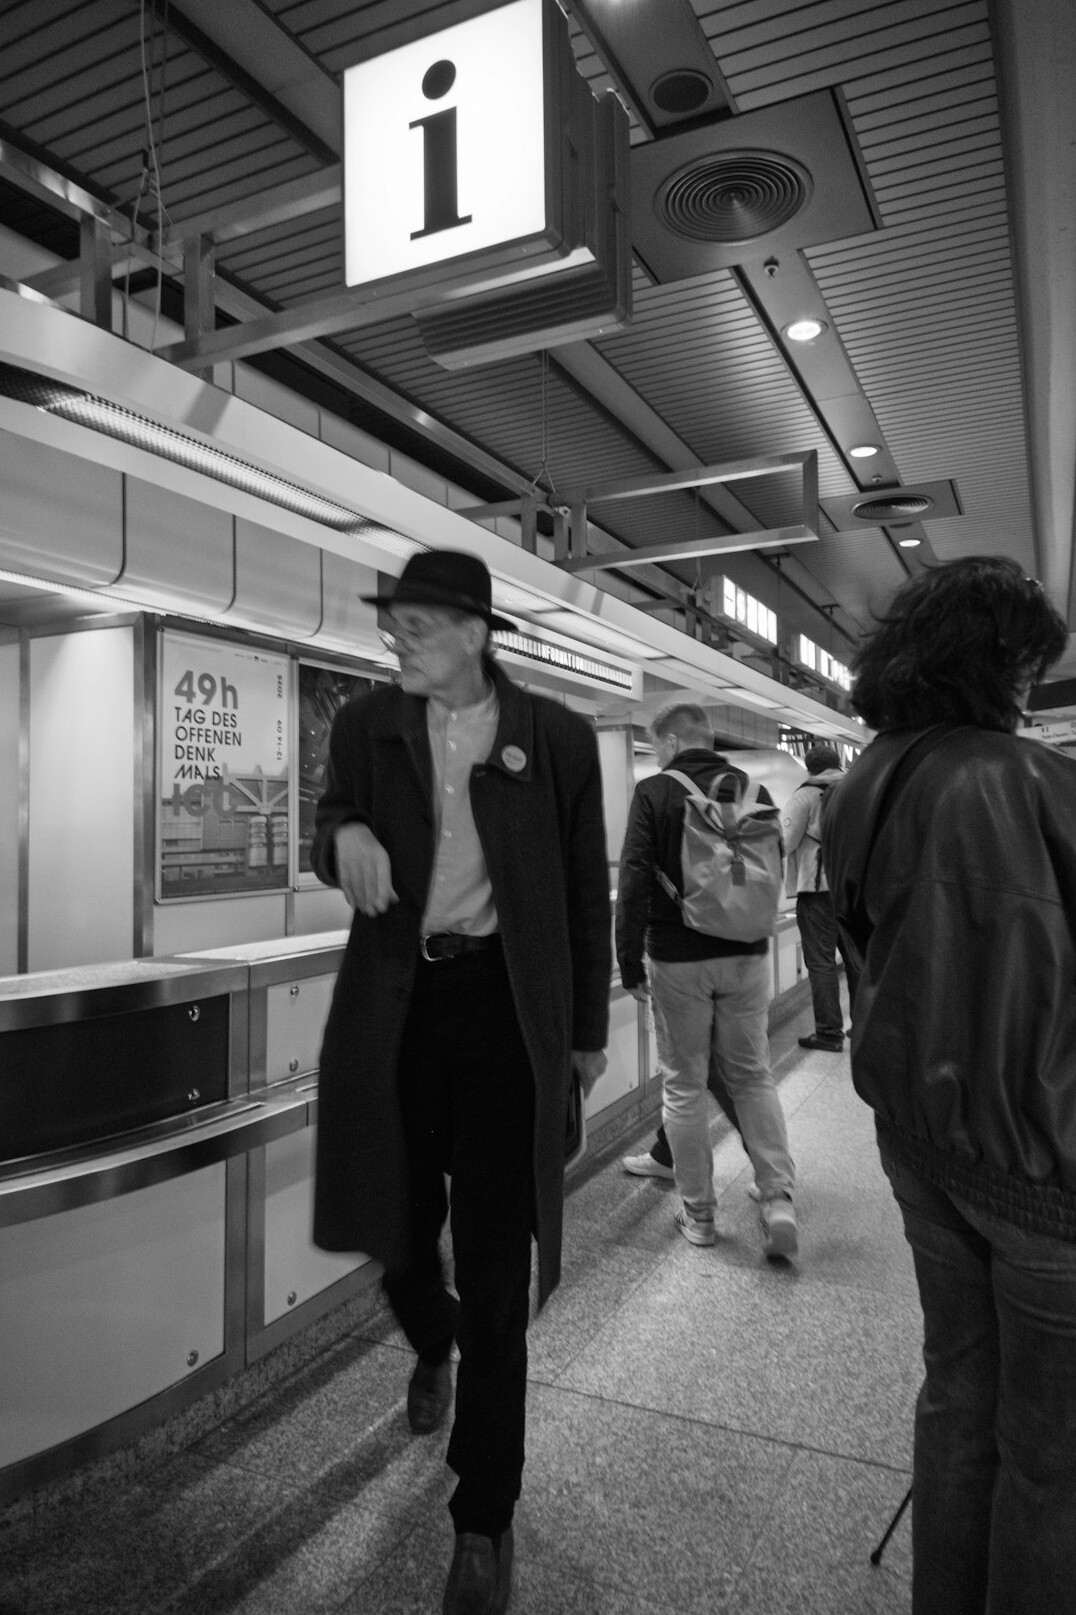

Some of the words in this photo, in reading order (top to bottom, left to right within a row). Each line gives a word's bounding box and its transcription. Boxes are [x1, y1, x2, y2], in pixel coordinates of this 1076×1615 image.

[409, 59, 472, 241] i
[174, 670, 238, 709] 49h
[174, 706, 206, 725] TAG
[212, 710, 237, 728] DES
[175, 726, 242, 746] OFFENEN
[174, 744, 216, 762] DENK
[174, 764, 221, 781] MALS
